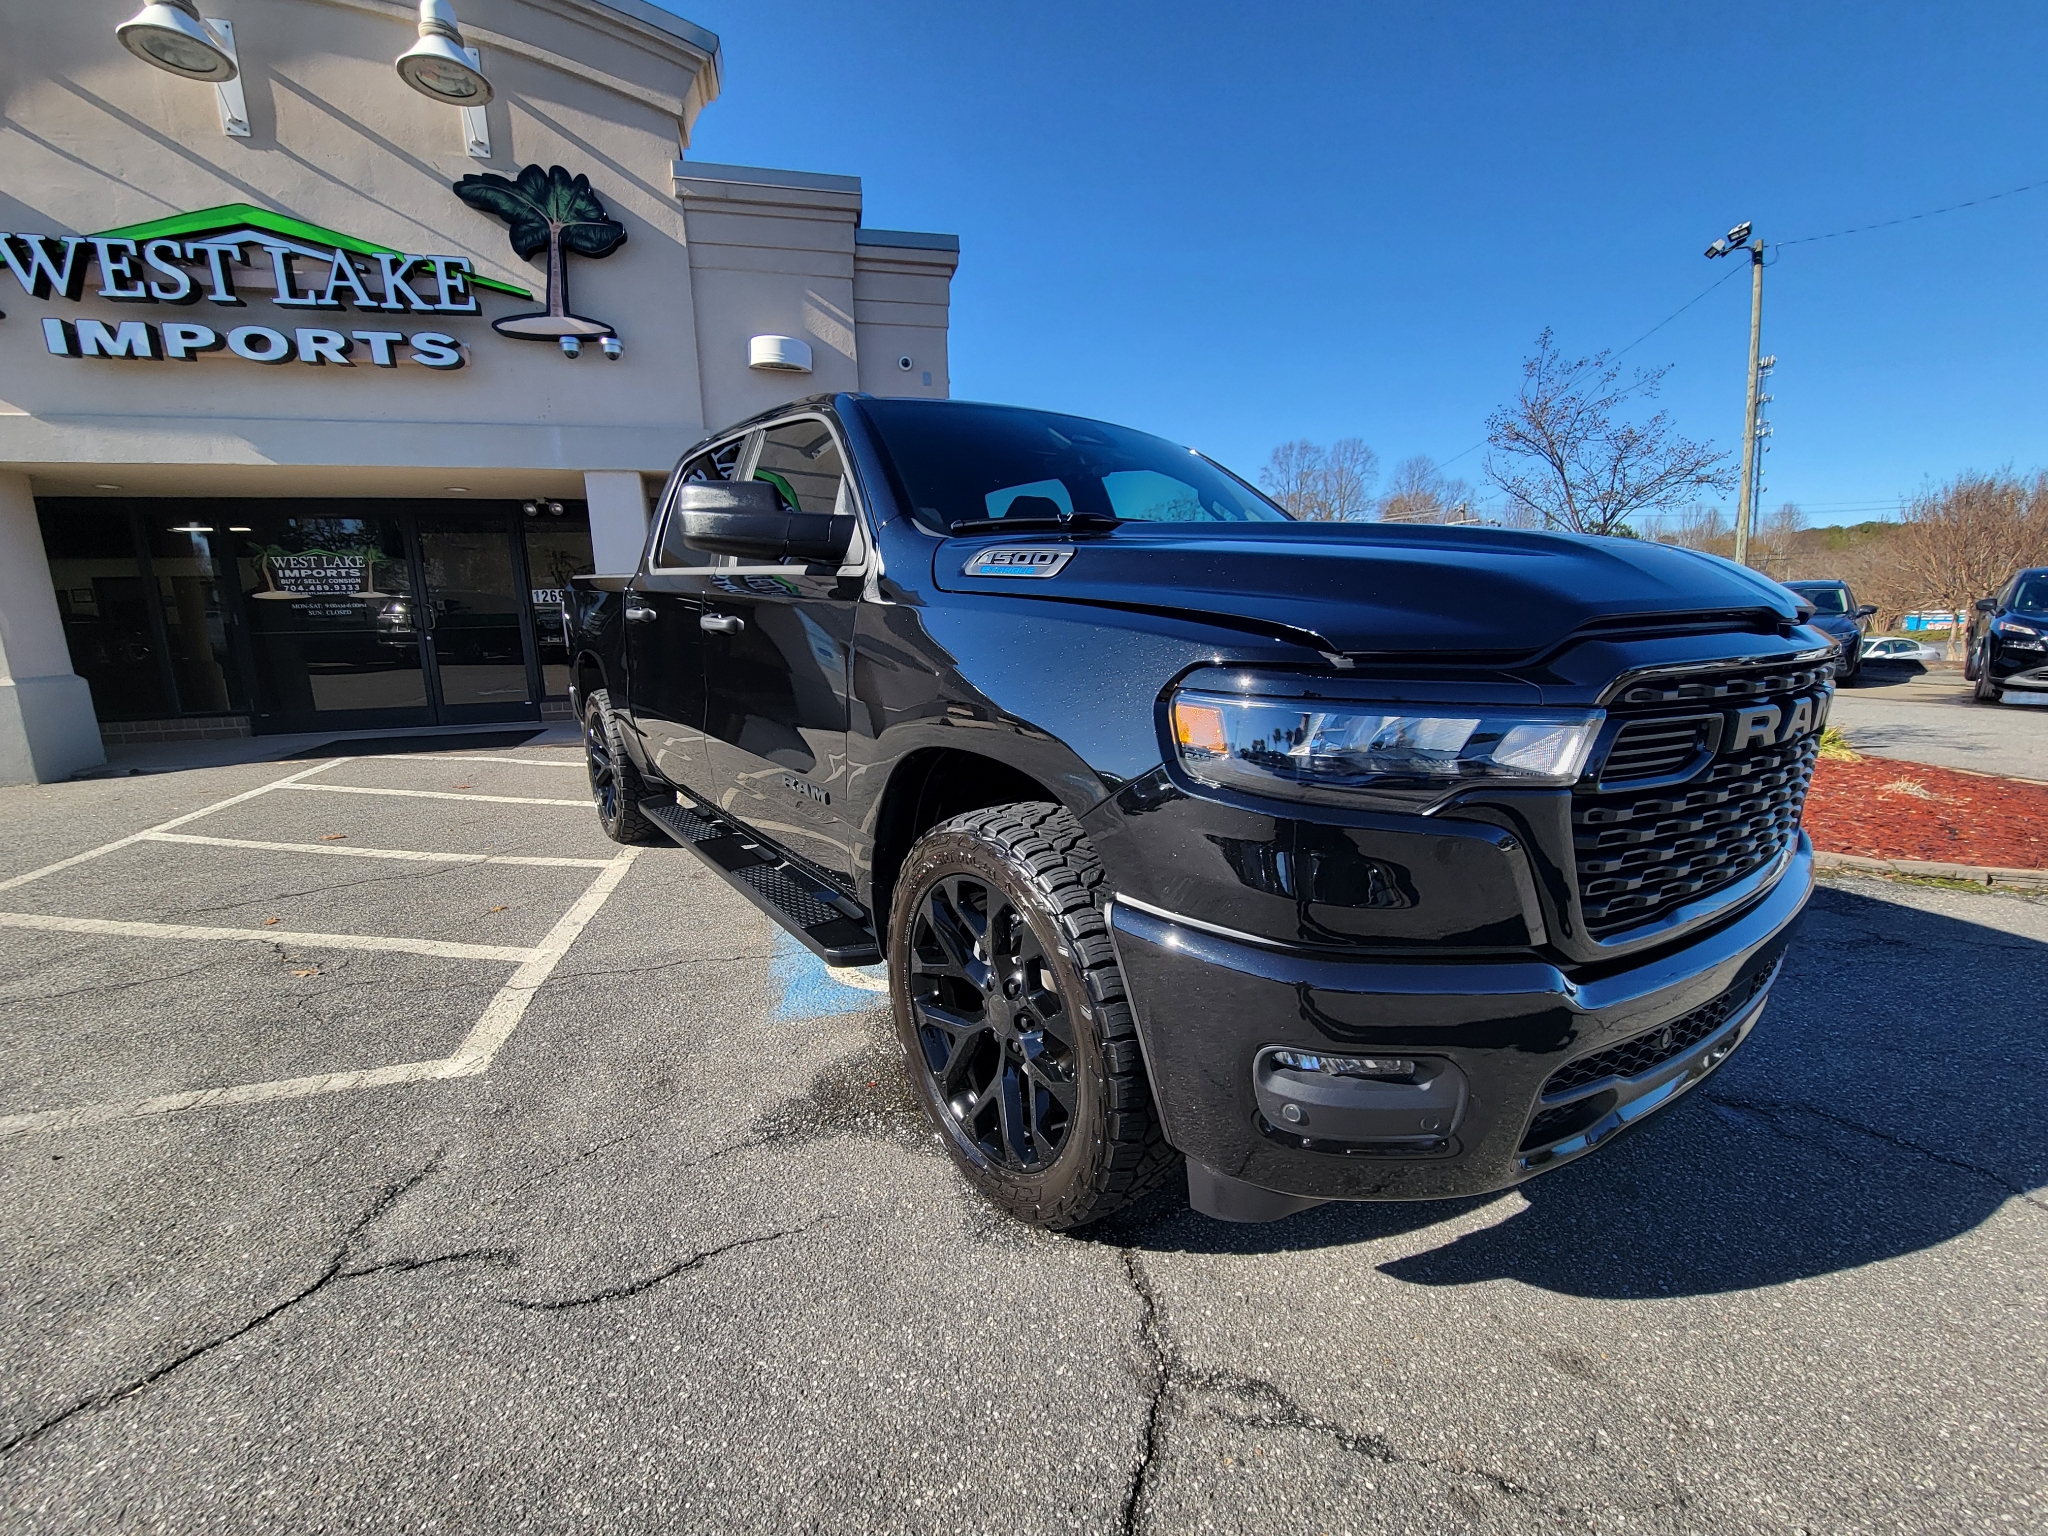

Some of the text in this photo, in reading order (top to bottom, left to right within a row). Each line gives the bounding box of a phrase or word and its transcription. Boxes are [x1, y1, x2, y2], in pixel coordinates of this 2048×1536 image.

[0, 231, 477, 313] WEST LAKE
[41, 317, 465, 368] IMPORTS
[270, 556, 366, 568] WEST LAKE
[979, 552, 1056, 565] 1500
[278, 569, 361, 578] IMPORTS
[284, 584, 360, 592] 704.489.9333
[1732, 679, 1835, 751] RAM
[782, 773, 831, 805] RAM
